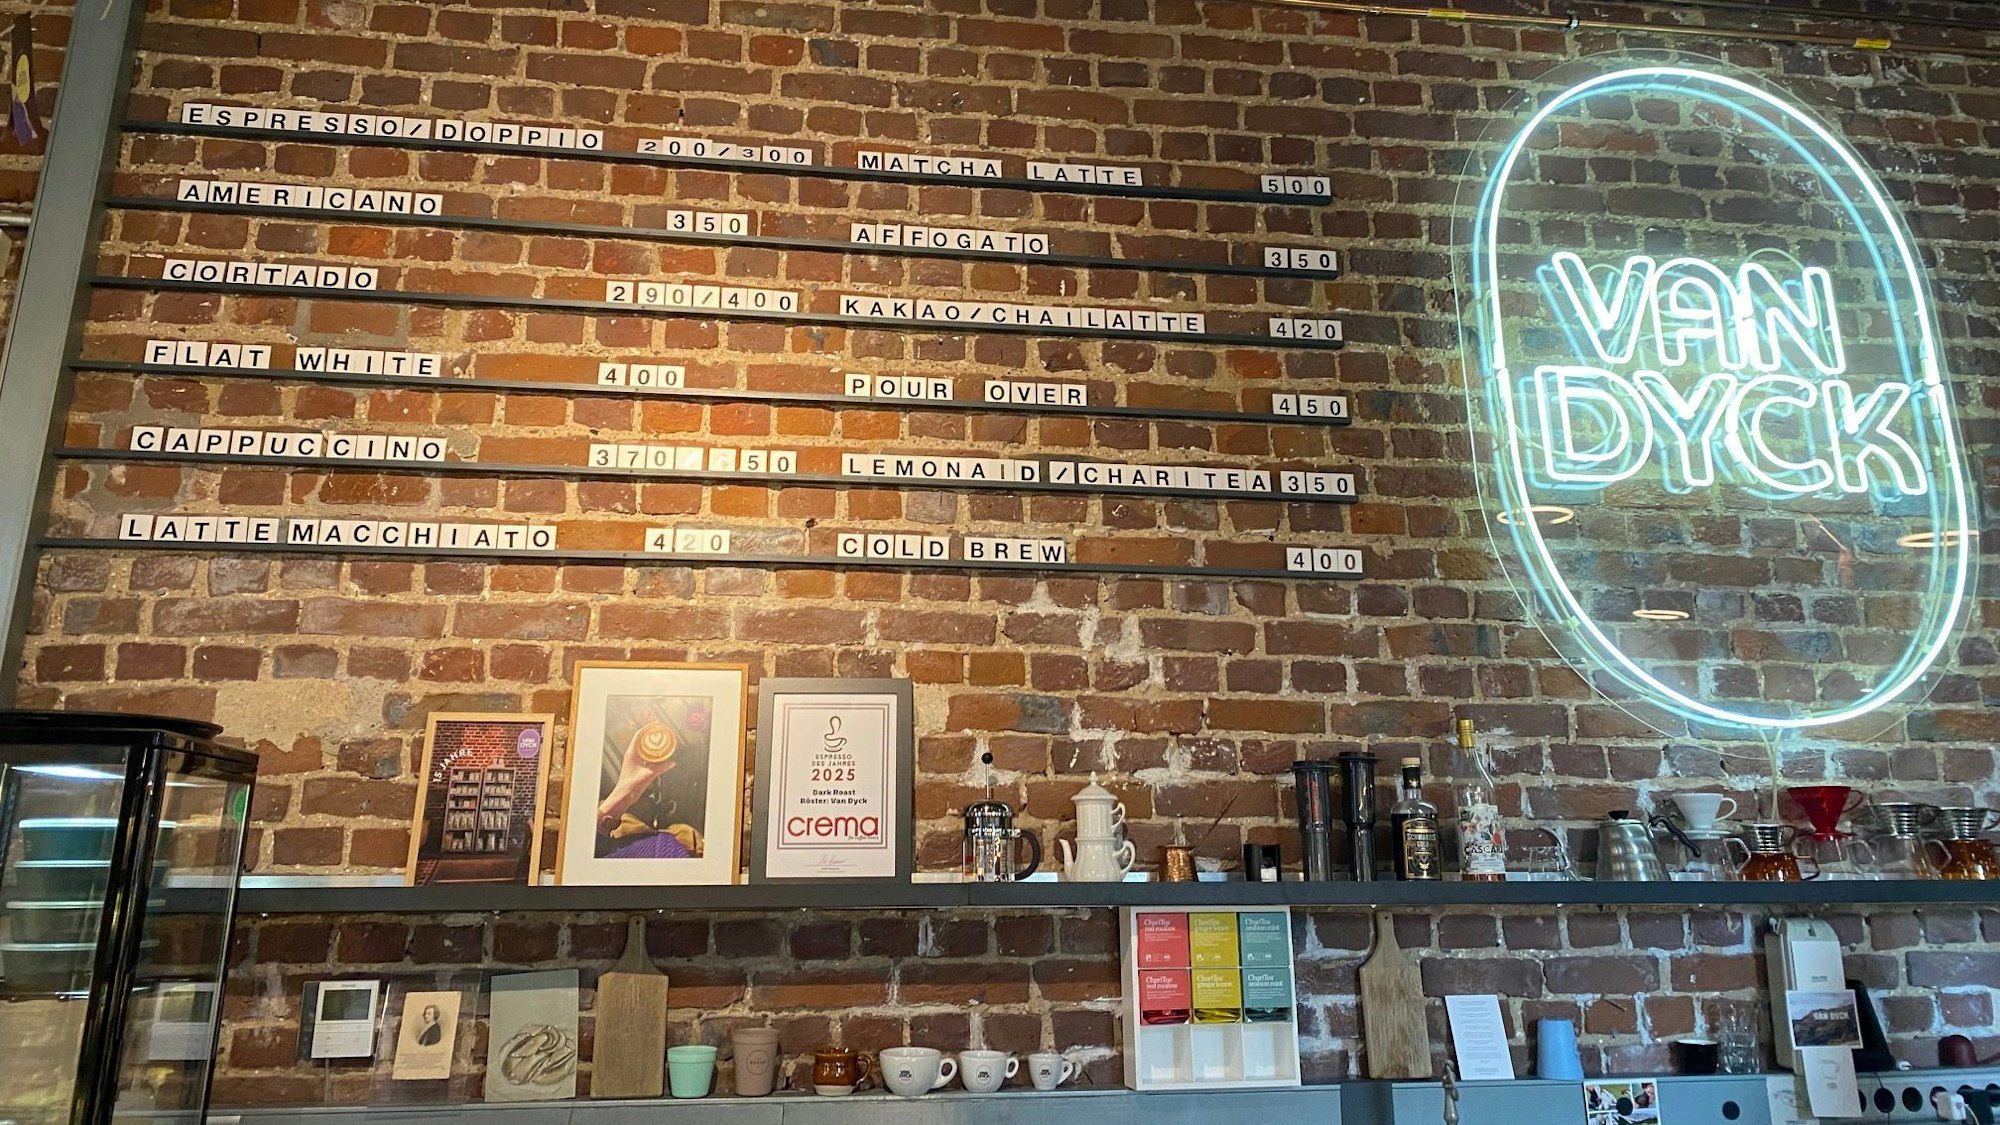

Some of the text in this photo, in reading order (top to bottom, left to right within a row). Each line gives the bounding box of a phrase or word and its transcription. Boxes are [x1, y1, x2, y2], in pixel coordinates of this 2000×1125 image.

[188, 107, 599, 149] ESPRESSO/DOPPIO
[644, 141, 806, 163] 200/300
[862, 155, 1137, 184] MATCHA LATTE
[1268, 179, 1325, 194] 500
[183, 184, 438, 214] AMERICANO
[673, 214, 741, 233] 350
[857, 228, 1043, 253] AFFOGATO
[1271, 251, 1331, 268] 350
[170, 263, 373, 289] CORTADO
[613, 286, 791, 310] 290/400
[1552, 252, 1845, 375] VAN
[1276, 322, 1336, 339] 420
[153, 345, 434, 375] FLAT WHITE
[605, 368, 678, 386] 400
[852, 379, 1082, 404] POUR OVER
[1279, 399, 1341, 415] 450
[1534, 364, 1928, 495] DYCK
[137, 431, 441, 460] CAPPUCCINO
[1288, 477, 1349, 493] 350
[128, 518, 550, 548] LATTE MACCHIATO
[653, 531, 723, 551] 420
[843, 538, 1062, 561] COLD BREW
[1293, 553, 1356, 570] 400
[440, 748, 473, 771] JAHRE
[811, 768, 855, 781] 2025
[847, 798, 868, 806] Dyck
[787, 816, 879, 837] crema
